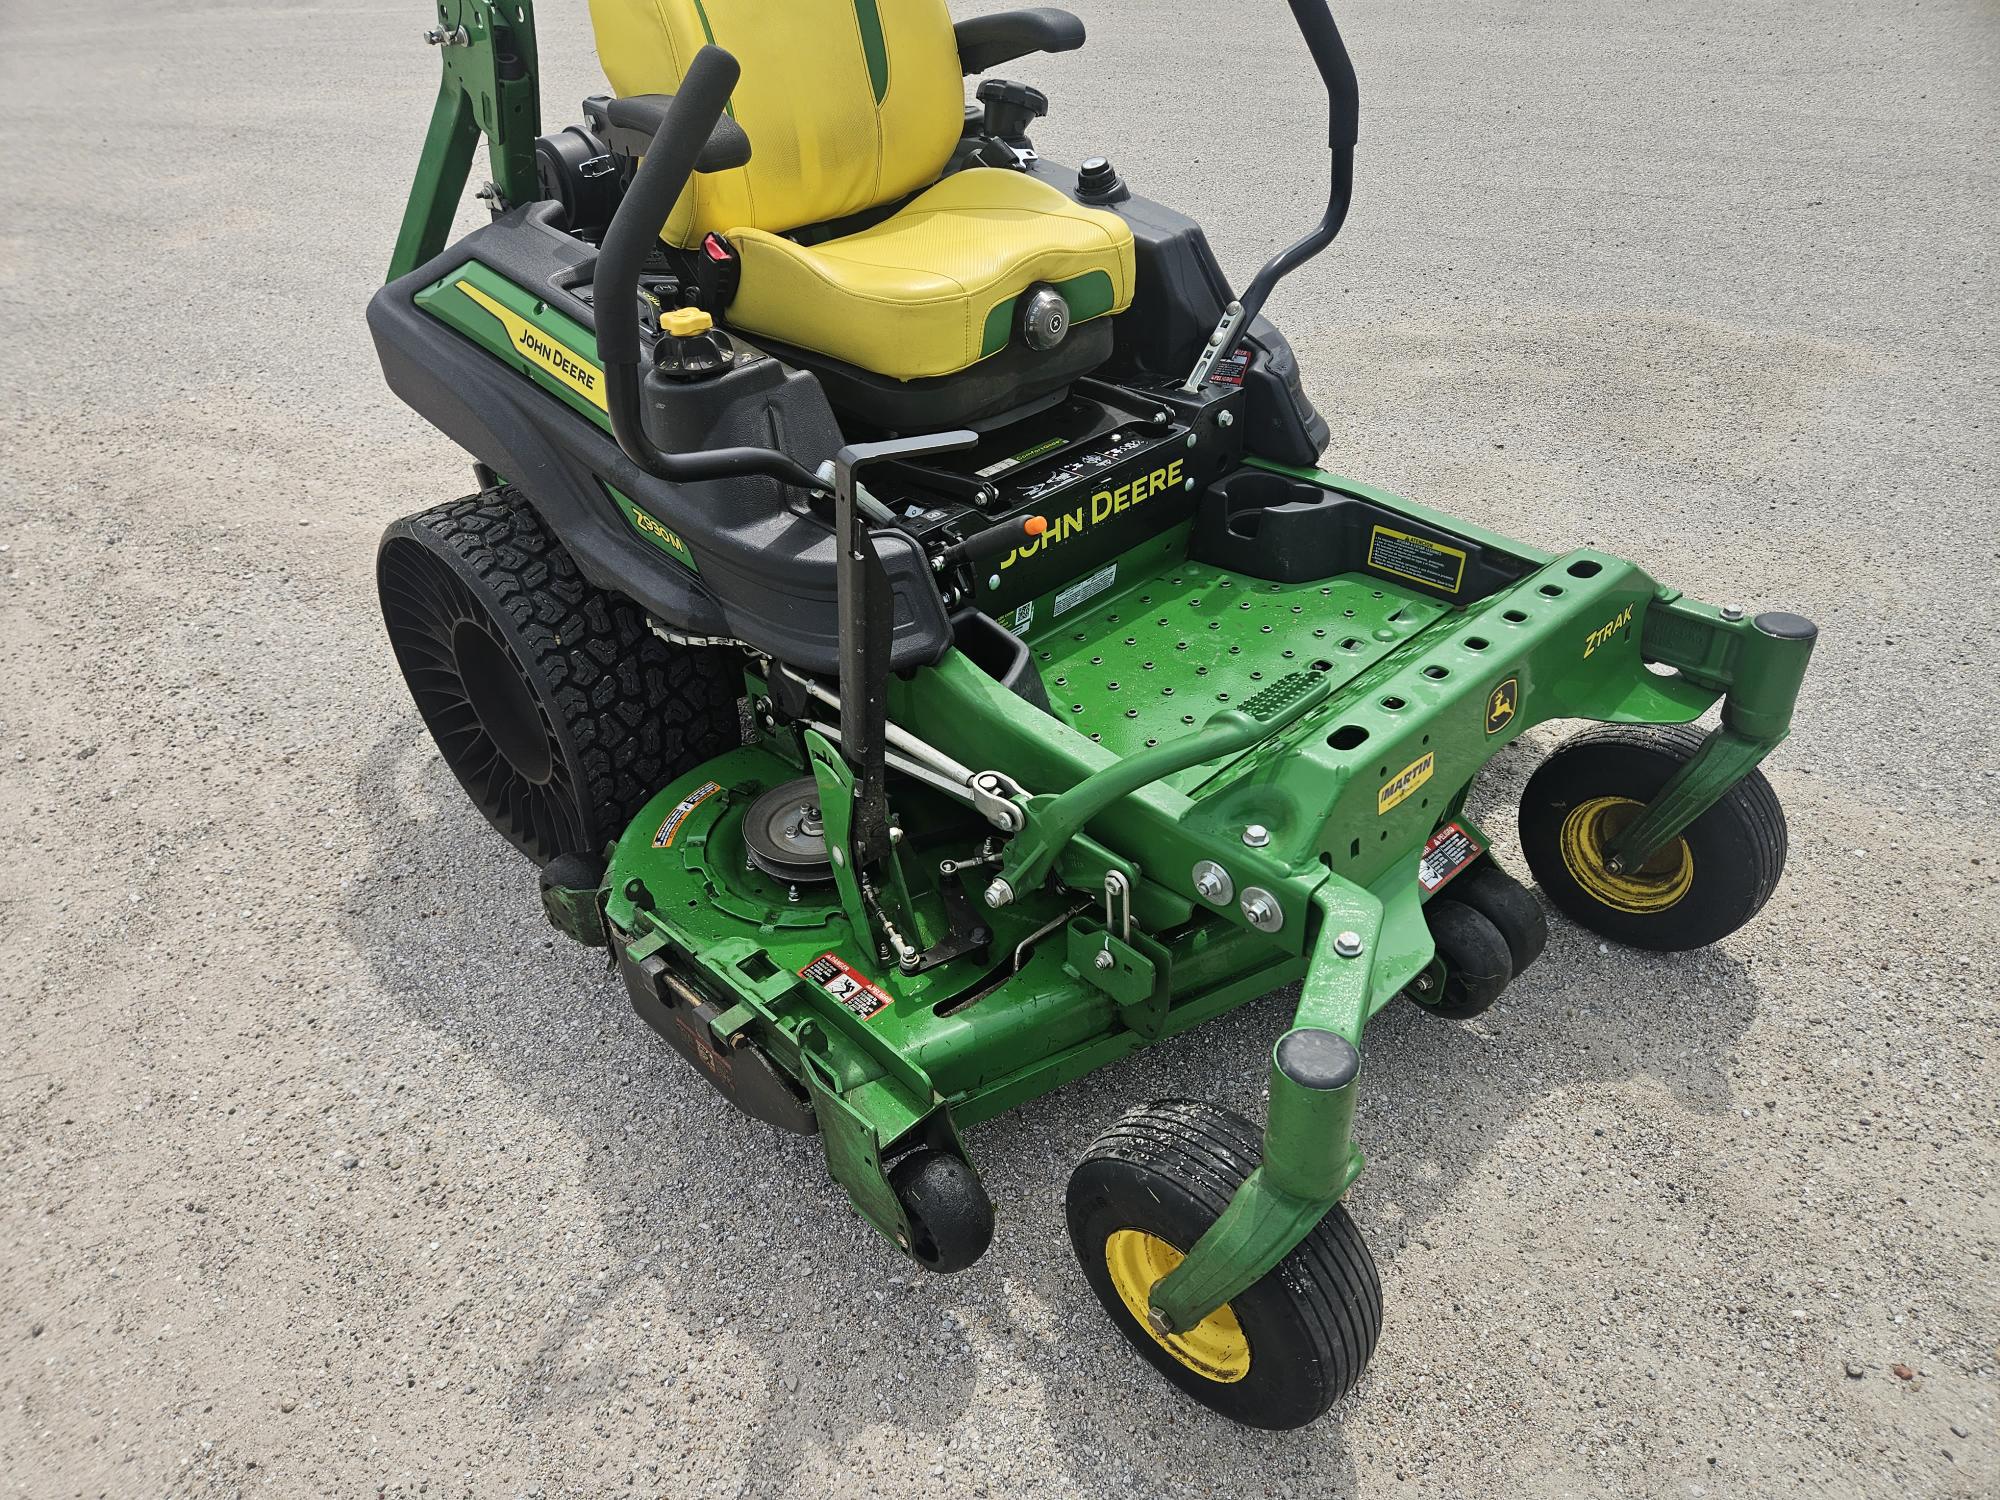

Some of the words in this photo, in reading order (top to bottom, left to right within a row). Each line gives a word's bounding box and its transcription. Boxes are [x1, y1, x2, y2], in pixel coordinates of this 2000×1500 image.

[520, 329, 551, 360] JOHN
[553, 349, 596, 390] DEERE
[1091, 458, 1184, 525] DEERE
[632, 507, 684, 553] Z930M
[1583, 603, 1634, 660] ZTRAK
[1381, 756, 1433, 803] MARTIN
[1438, 826, 1455, 843] PELIGRO
[830, 956, 850, 972] DANGER
[871, 985, 894, 1004] PELIGRO
